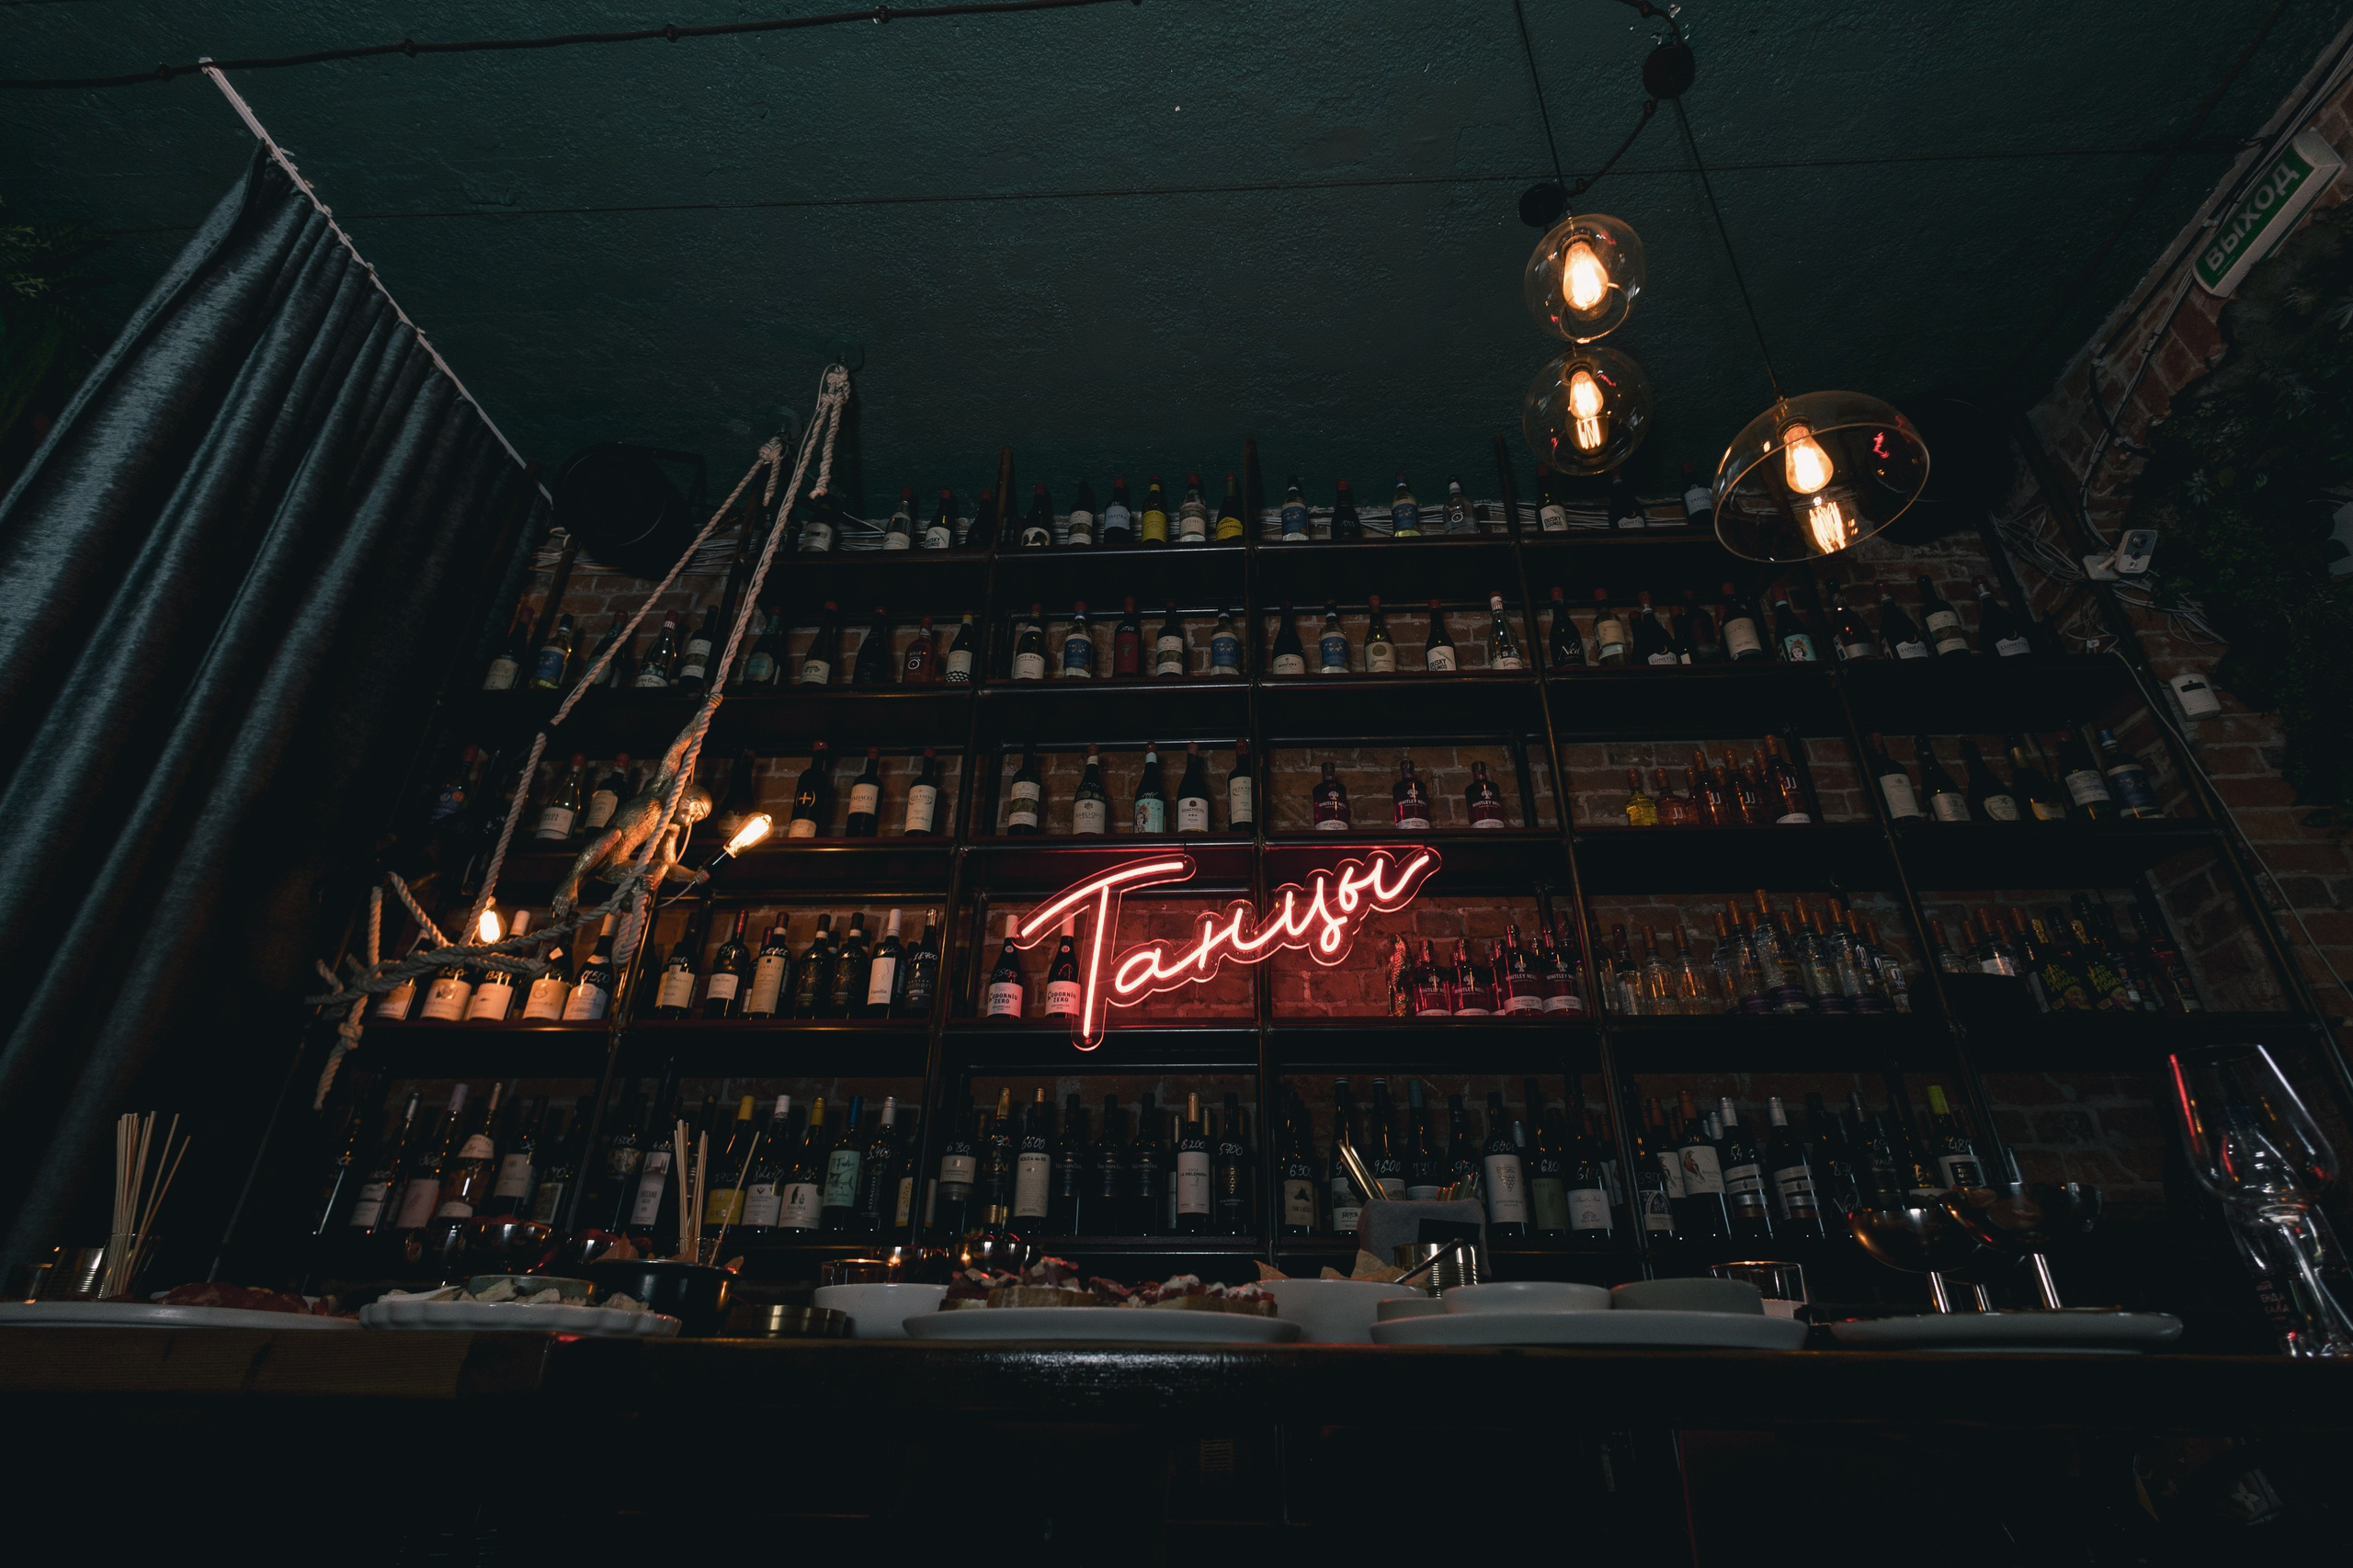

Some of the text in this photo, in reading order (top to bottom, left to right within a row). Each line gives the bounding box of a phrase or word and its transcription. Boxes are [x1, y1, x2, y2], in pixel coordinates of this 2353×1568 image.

[2204, 161, 2301, 272] ВЫХОД
[1558, 641, 1581, 662] Ned
[1021, 854, 1431, 1038] Танцы
[868, 1176, 877, 1210] ADAGIO
